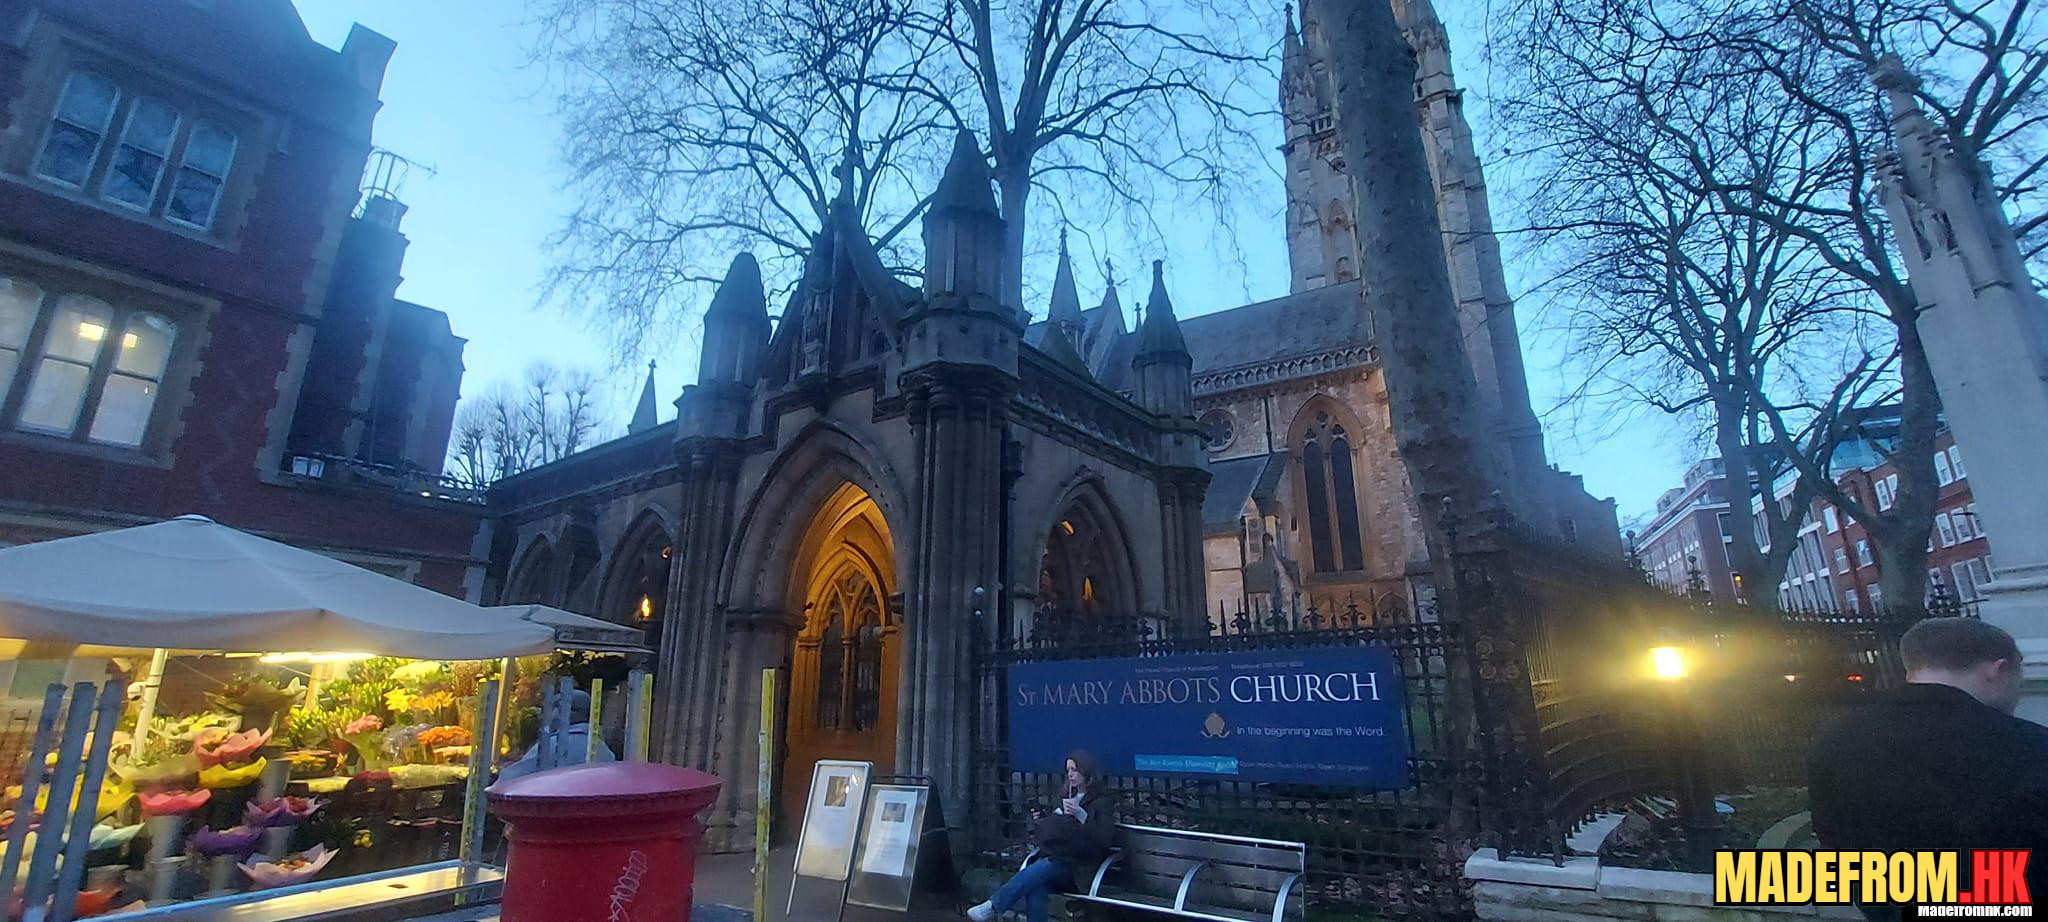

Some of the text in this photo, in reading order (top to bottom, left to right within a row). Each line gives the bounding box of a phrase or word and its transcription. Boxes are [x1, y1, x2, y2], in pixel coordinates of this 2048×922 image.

[1043, 680, 1113, 706] MARY
[1119, 676, 1221, 704] ABBOTS
[1230, 671, 1381, 703] CHURCH
[1236, 726, 1246, 736] In
[1247, 726, 1263, 736] the
[1264, 726, 1311, 738] beginning
[1312, 727, 1334, 736] was
[1335, 726, 1353, 736] the
